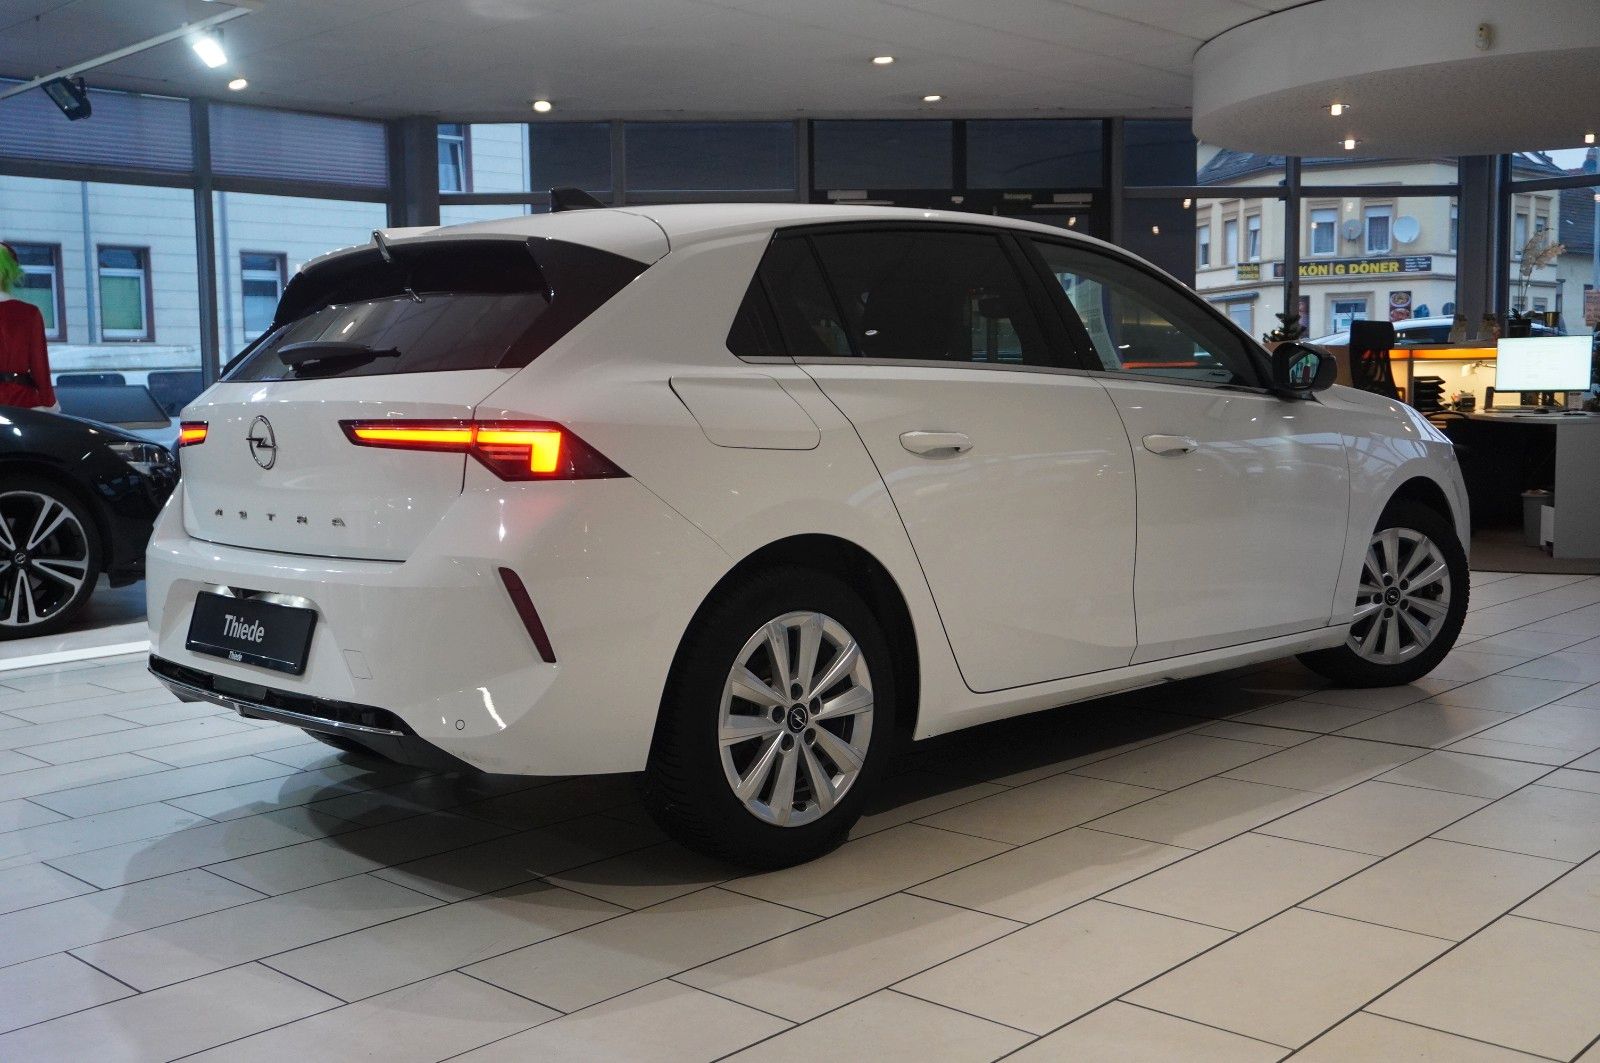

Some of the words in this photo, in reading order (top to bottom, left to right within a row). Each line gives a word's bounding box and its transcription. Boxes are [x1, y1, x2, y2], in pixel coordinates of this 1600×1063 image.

[1349, 260, 1399, 274] DÖNER
[214, 508, 346, 528] ASTRA
[223, 614, 265, 643] Thiede
[228, 650, 243, 662] Thiede
